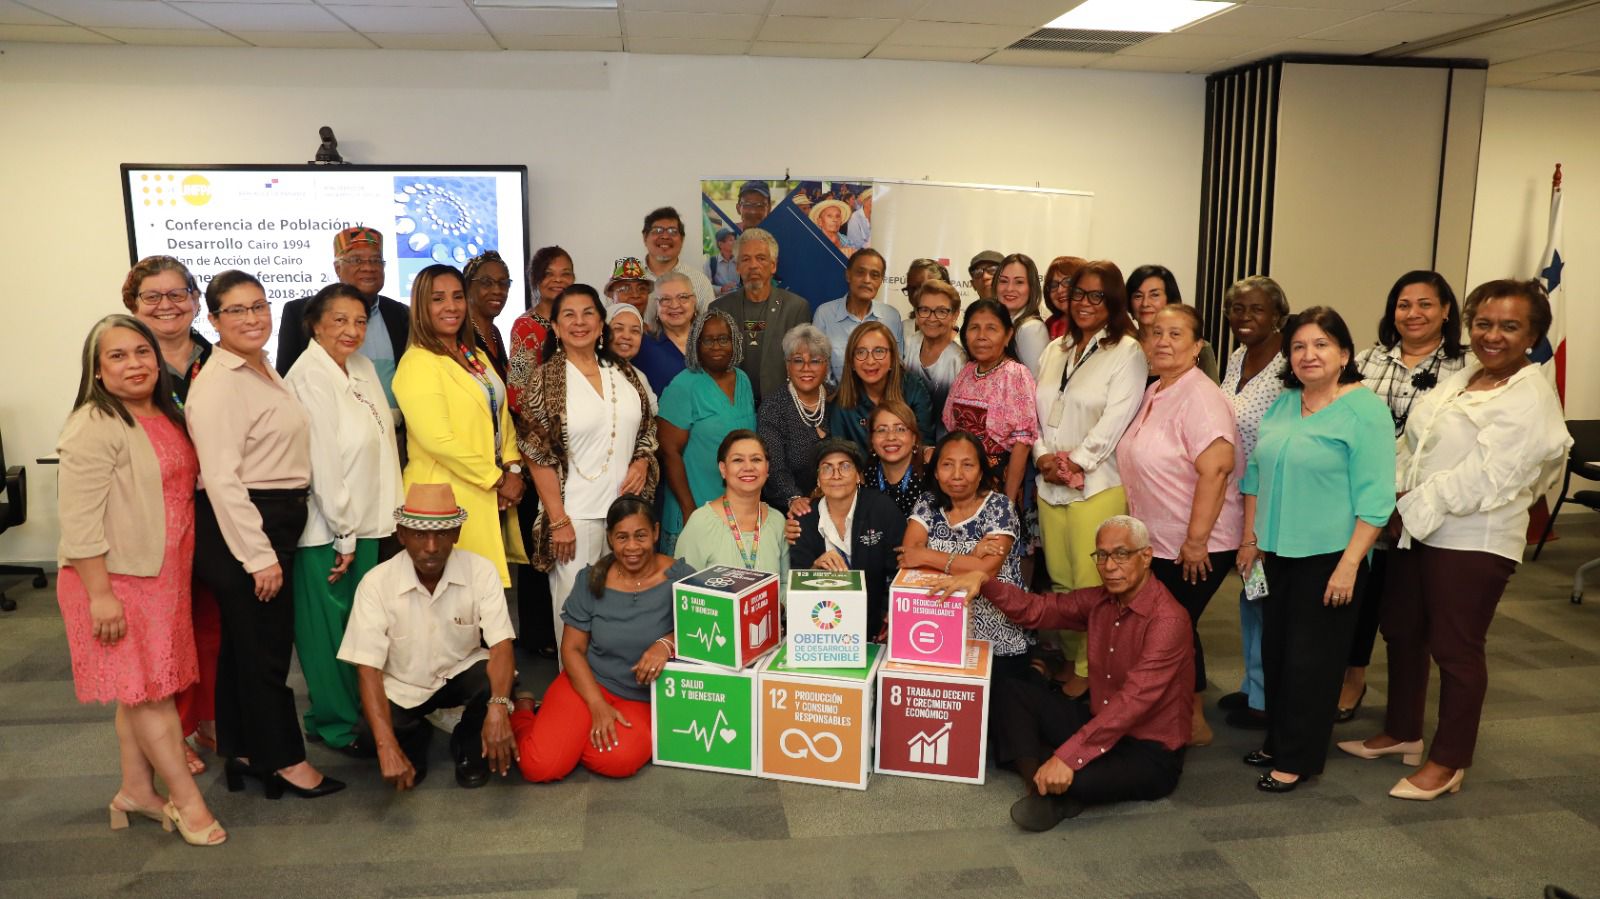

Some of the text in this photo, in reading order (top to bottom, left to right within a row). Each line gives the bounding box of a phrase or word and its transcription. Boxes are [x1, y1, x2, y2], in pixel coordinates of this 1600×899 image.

[165, 219, 252, 230] Conferencia
[258, 219, 275, 230] de
[280, 218, 350, 230] Población
[167, 238, 310, 249] Desarrollo Cairo 1994
[196, 255, 211, 266] de
[214, 255, 250, 265] Acción
[253, 255, 271, 265] del
[273, 255, 303, 265] Cairo
[256, 271, 312, 282] ferencia
[681, 595, 706, 610] 3 SALUD
[896, 597, 910, 613] 10
[794, 633, 860, 645] OBJETIVOS
[794, 652, 860, 662] SOSTENIBLE
[665, 677, 704, 698] 3 SALUD
[681, 690, 726, 703] Y BIENESTAR
[769, 688, 843, 710] 12 PRODUCCIÓN
[890, 685, 976, 706] 8 TRABAJO DECENTE
[794, 701, 838, 714] Y CONSUMO
[906, 697, 962, 711] Y CRECIMIENTO
[794, 711, 852, 727] RESPONSABLES
[905, 708, 949, 720] ECONÓMICO
